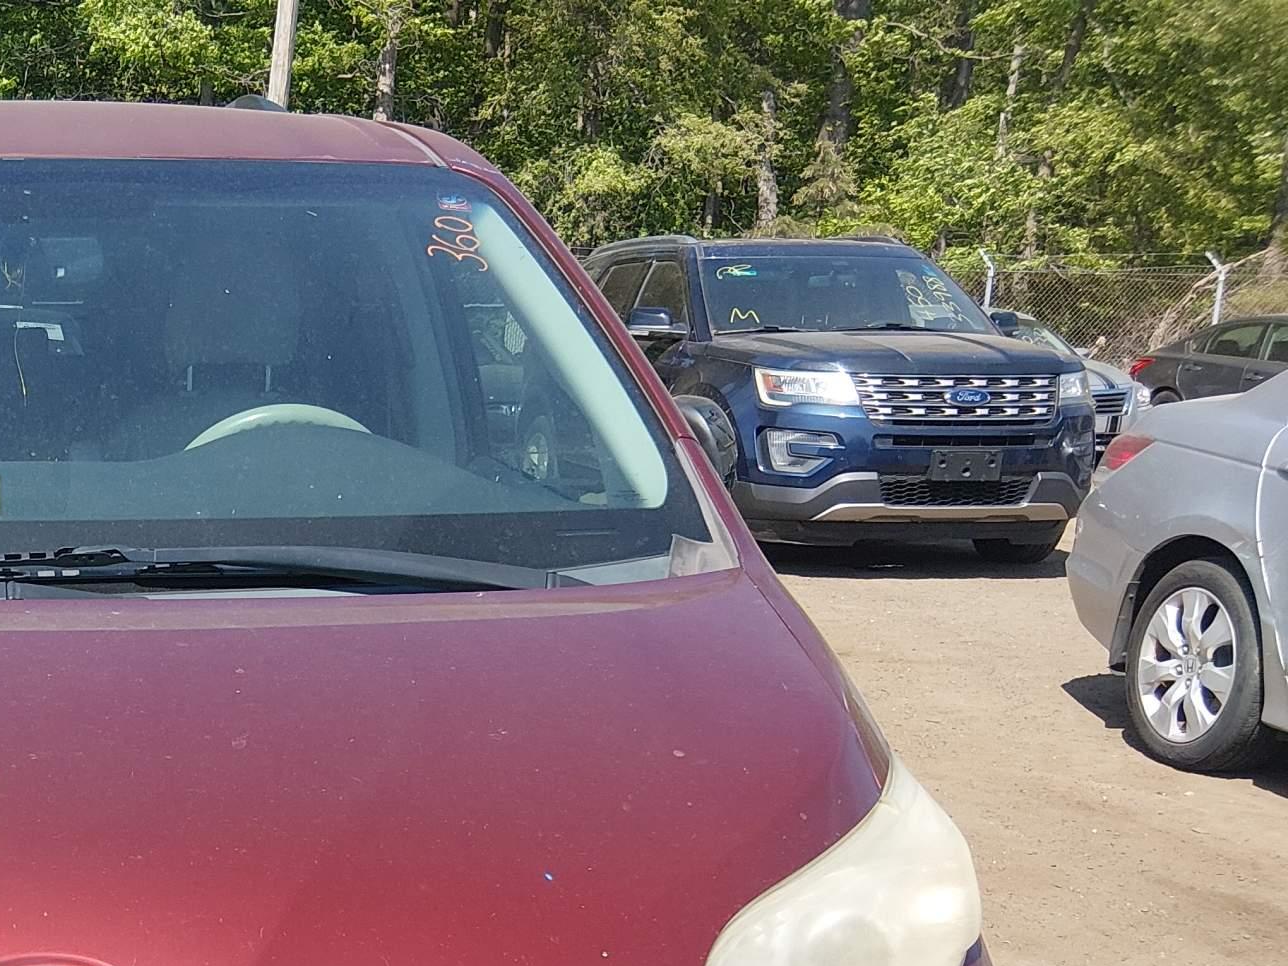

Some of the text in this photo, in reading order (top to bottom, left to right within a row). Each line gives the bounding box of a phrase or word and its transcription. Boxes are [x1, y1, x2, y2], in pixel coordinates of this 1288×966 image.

[427, 215, 488, 272] 360
[730, 307, 760, 323] M
[956, 390, 982, 402] Ford
